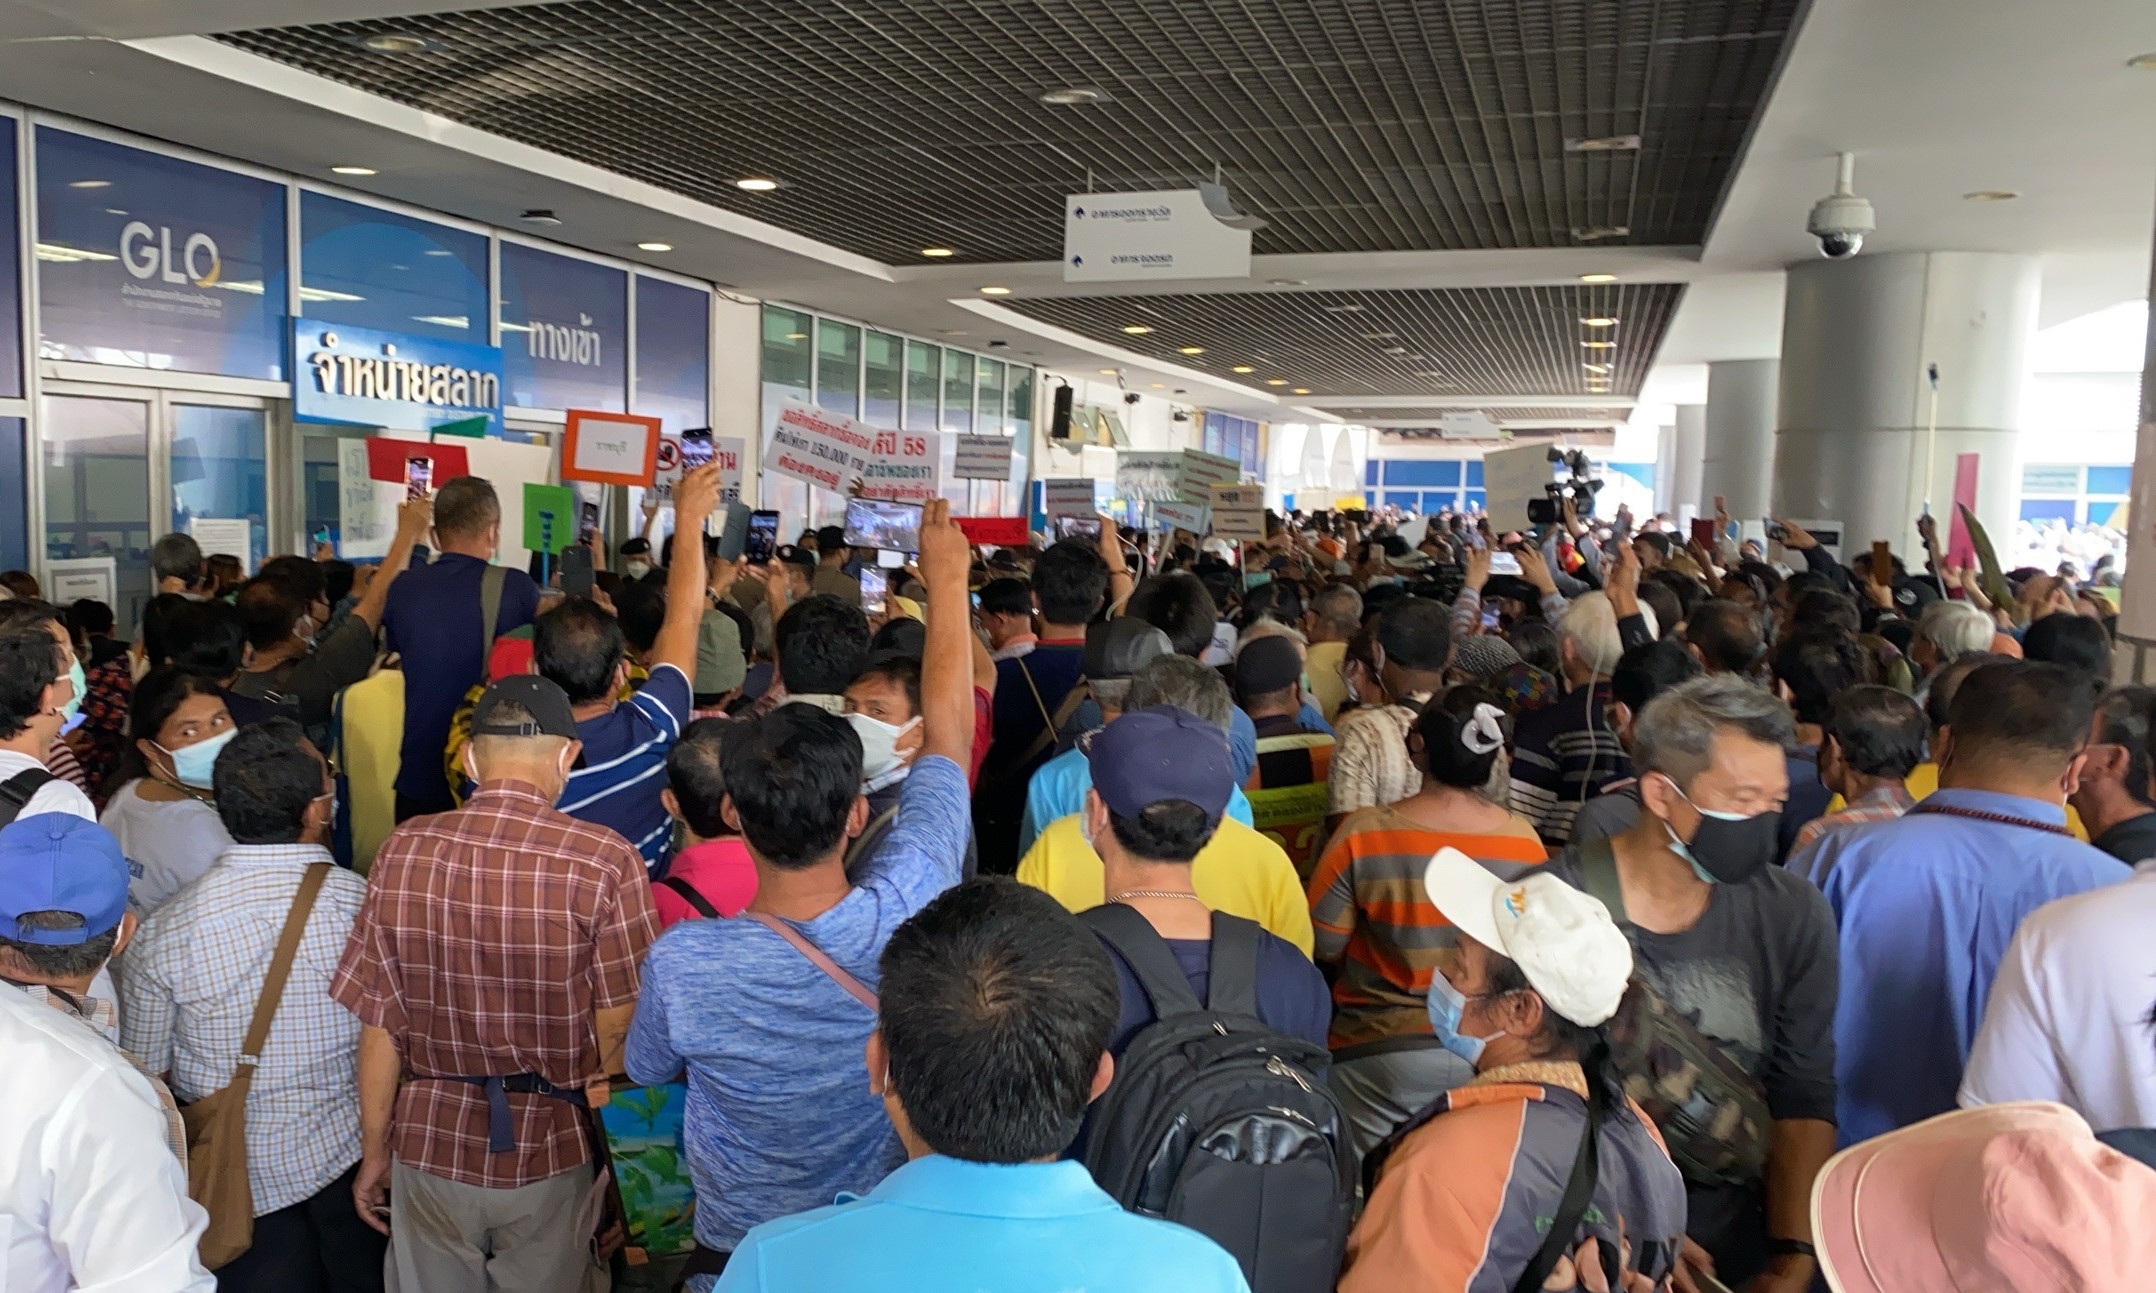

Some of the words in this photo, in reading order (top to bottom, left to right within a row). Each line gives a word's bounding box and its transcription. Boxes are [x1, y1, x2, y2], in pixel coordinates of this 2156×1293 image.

[120, 221, 221, 288] GLO
[312, 331, 500, 409] จำหน่ายสลาก
[903, 437, 926, 457] 58
